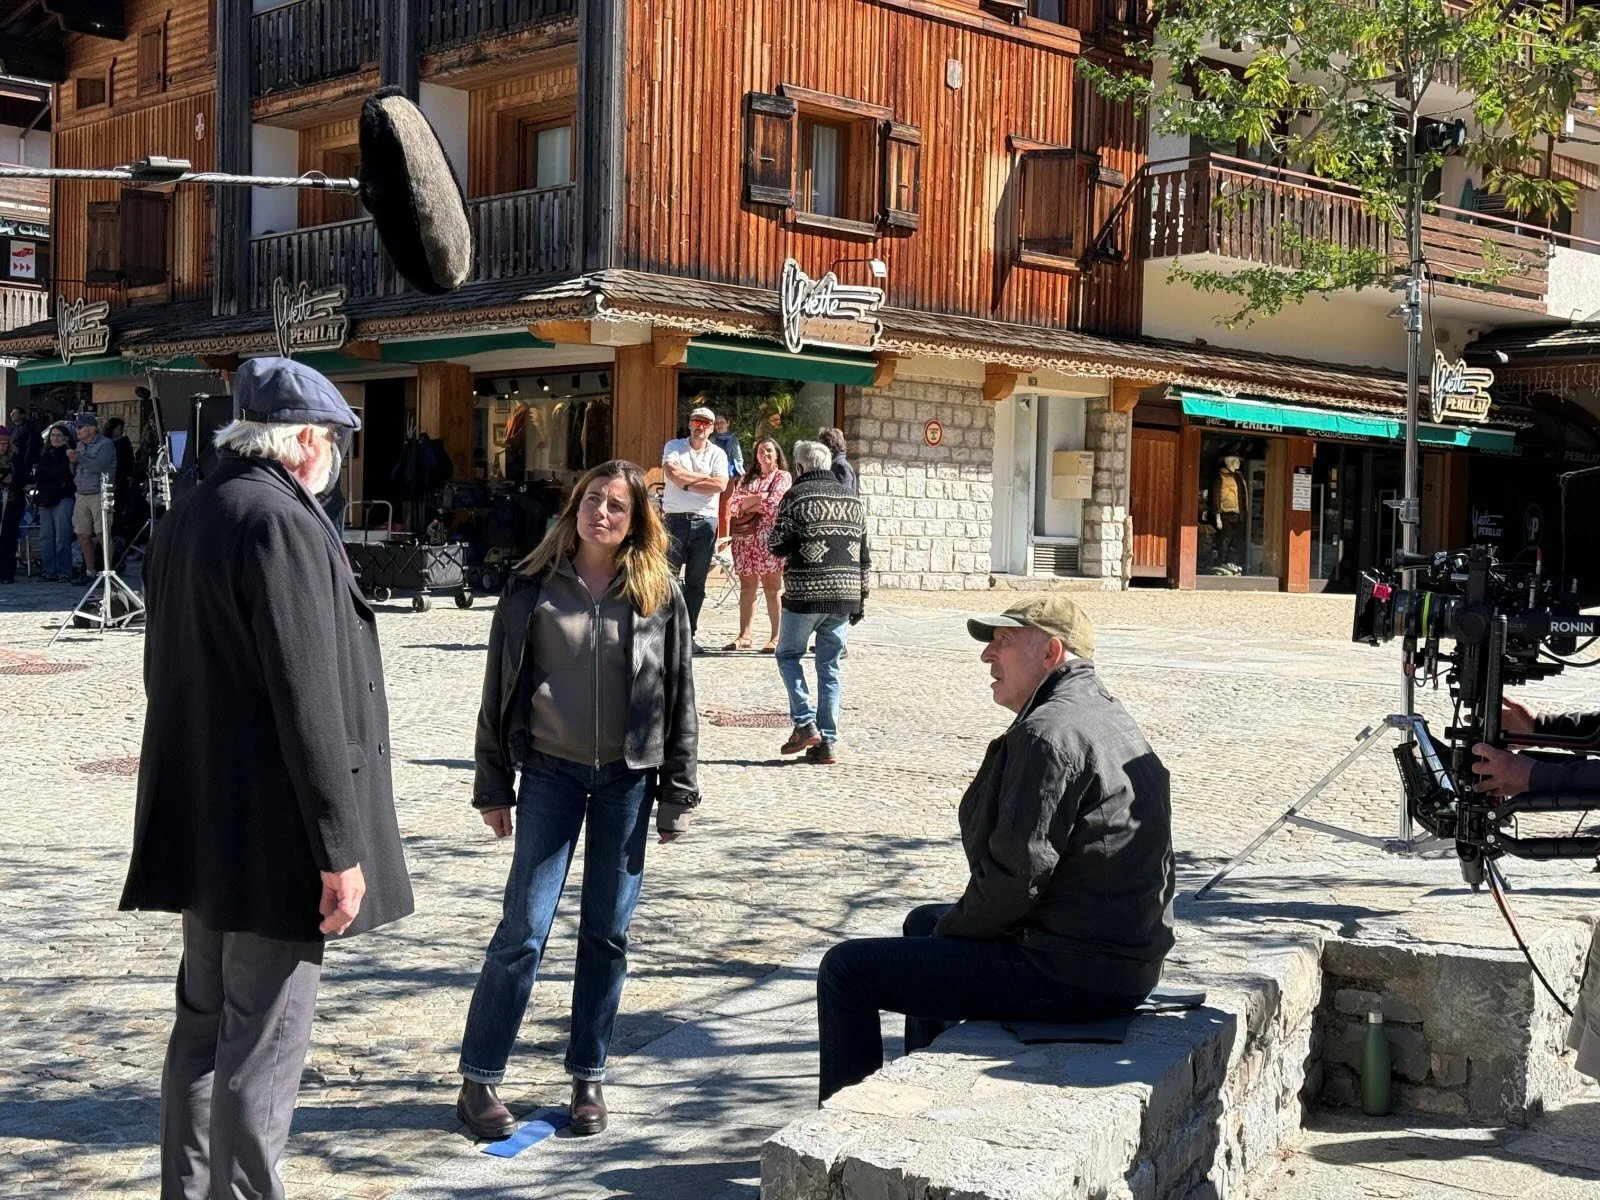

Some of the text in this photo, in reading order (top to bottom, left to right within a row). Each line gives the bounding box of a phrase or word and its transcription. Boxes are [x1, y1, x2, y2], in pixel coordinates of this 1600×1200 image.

[787, 266, 880, 344] Yvette
[276, 284, 341, 354] Yvette
[69, 332, 104, 349] PERILLAT
[290, 324, 339, 344] PERILLAT
[1436, 362, 1490, 415] Yvette
[1445, 397, 1487, 413] PERILLAT
[1550, 621, 1594, 633] RONIN
